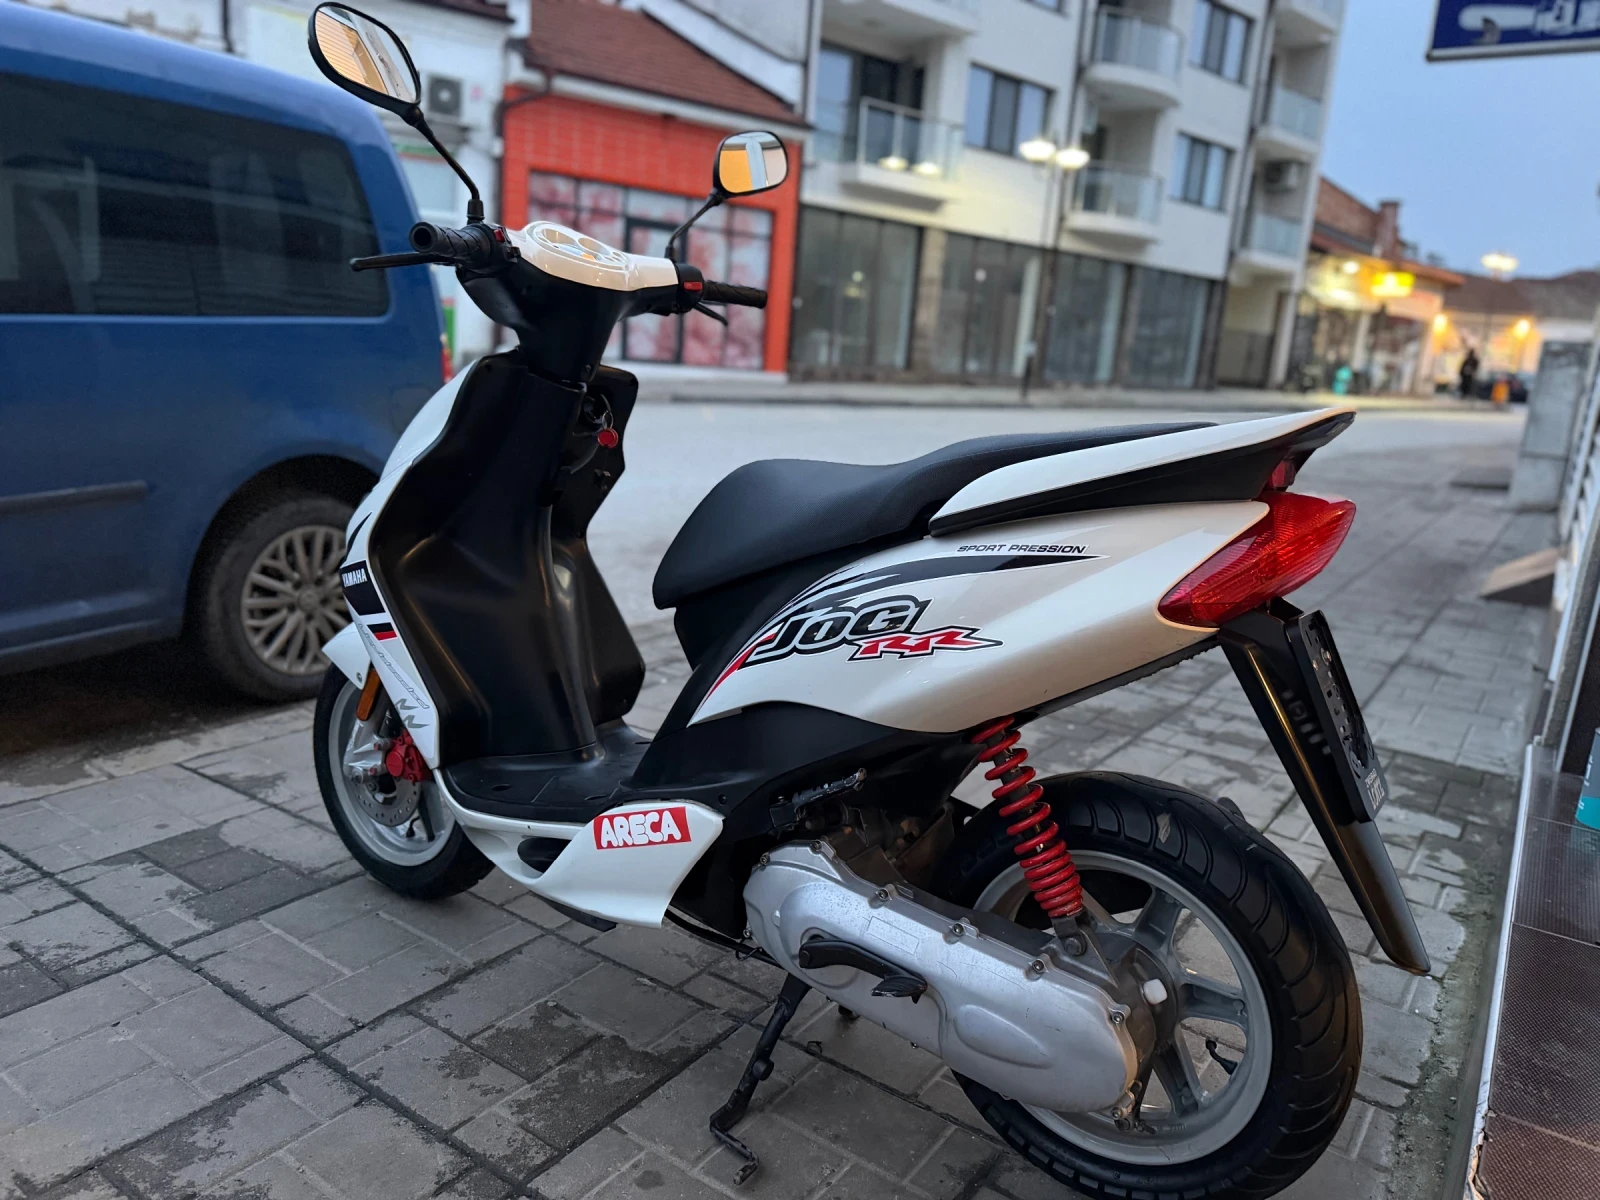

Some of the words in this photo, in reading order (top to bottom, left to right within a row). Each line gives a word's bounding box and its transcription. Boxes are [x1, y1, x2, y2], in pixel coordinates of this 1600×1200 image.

[957, 544, 1006, 553] SPORT
[1008, 544, 1086, 554] PRESSION
[341, 568, 368, 588] YAMAHA
[744, 597, 922, 664] JOG
[850, 627, 998, 660] RR
[600, 810, 682, 848] ARECA
